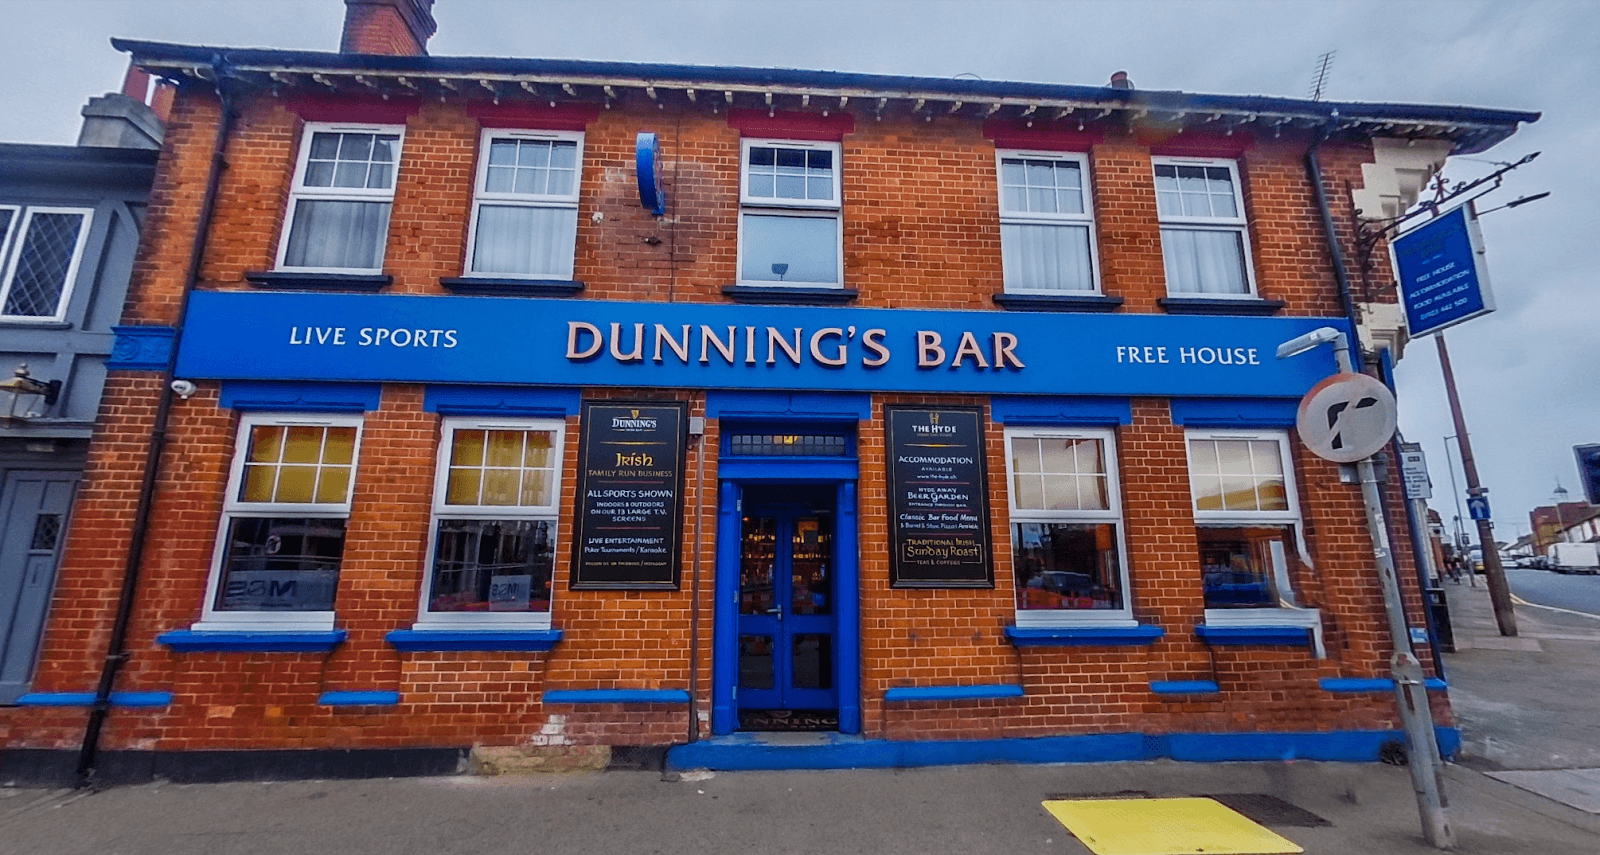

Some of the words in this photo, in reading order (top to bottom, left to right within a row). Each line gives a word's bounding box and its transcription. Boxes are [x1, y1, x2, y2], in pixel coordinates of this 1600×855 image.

[289, 326, 346, 345] LIVE
[358, 327, 458, 348] SPORTS
[565, 321, 891, 368] DUNNING'S
[916, 330, 1026, 370] BAR
[1116, 346, 1169, 364] FREE
[1179, 347, 1260, 365] HOUSE
[611, 418, 657, 428] DUNNING'S
[912, 425, 930, 433] THE
[931, 424, 957, 434] HYDE
[898, 455, 973, 465] ACCOMMODATION
[588, 469, 617, 477] FAMILY
[638, 470, 673, 478] BUSINESS
[638, 489, 674, 498] SHOWN
[907, 491, 930, 500] BEER
[941, 513, 959, 521] Food
[959, 513, 979, 521] Menu
[906, 538, 954, 546] TRADITIONAL
[906, 545, 949, 559] Sunday
[950, 546, 979, 556] Roast
